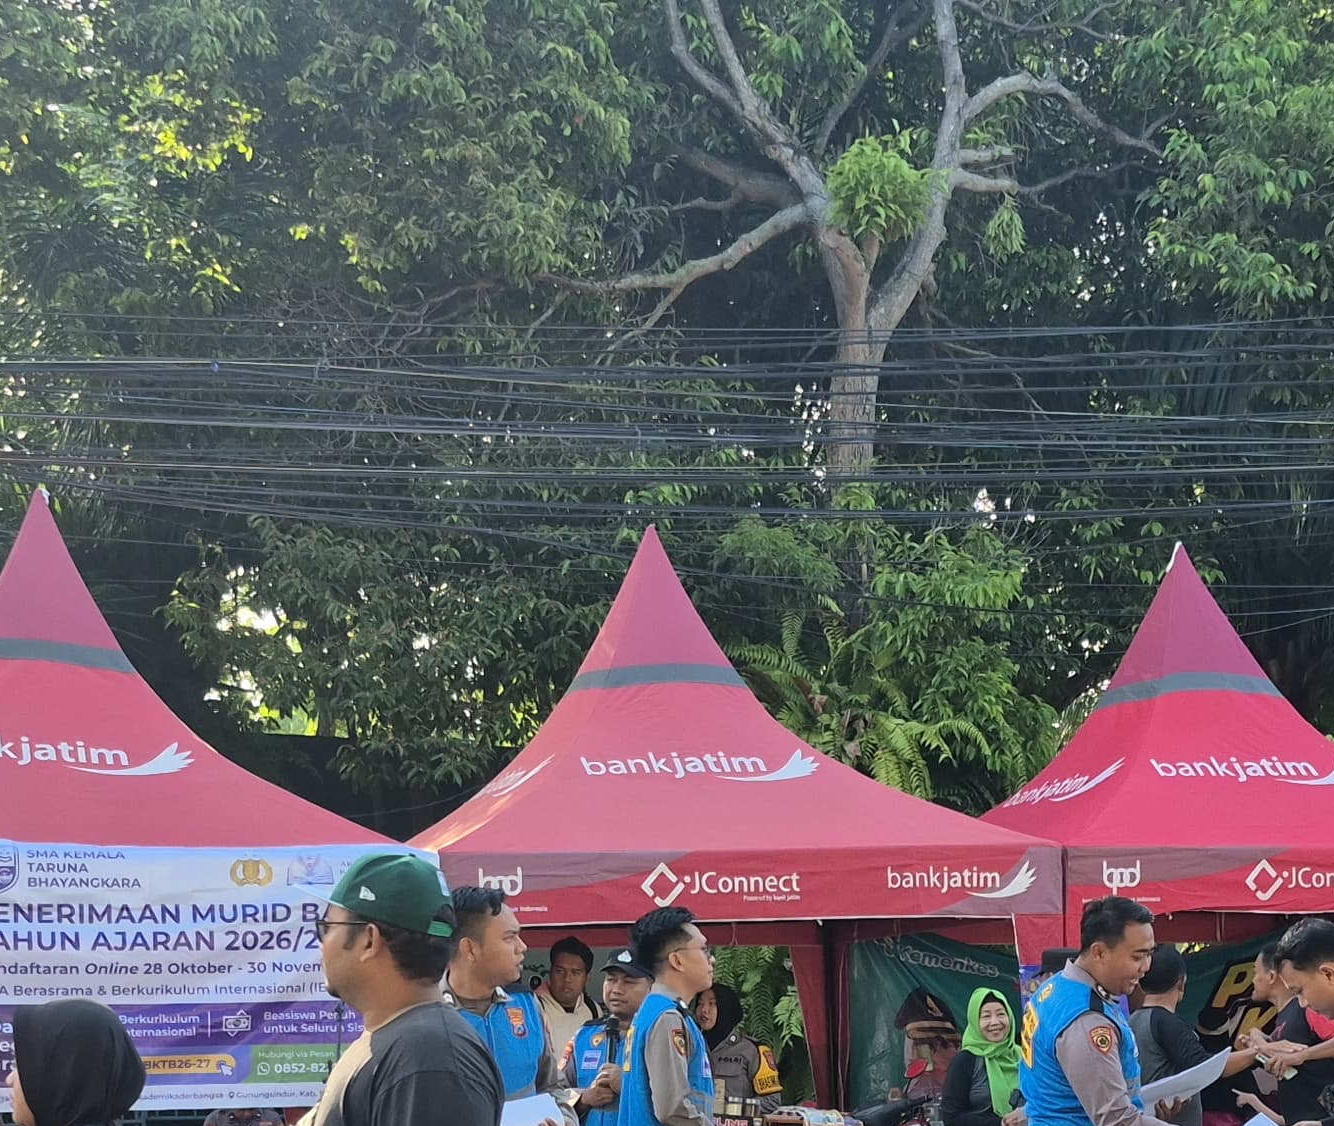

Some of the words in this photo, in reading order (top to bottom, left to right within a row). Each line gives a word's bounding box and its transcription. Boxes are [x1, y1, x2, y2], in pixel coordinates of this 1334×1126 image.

[580, 751, 767, 778] bankjatim
[1150, 756, 1318, 782] bankjatim
[63, 850, 125, 860] KEMALA
[27, 862, 88, 873] TARUNA
[28, 877, 141, 888] BHAYANGKARA
[690, 871, 800, 895] JConnect
[887, 866, 1000, 893] bankjatim
[192, 902, 292, 924] MURID
[92, 930, 216, 951] AJARAN
[85, 962, 139, 975] Online
[143, 963, 162, 975] 28
[167, 961, 233, 975] Oktober
[247, 962, 267, 974] 30
[14, 985, 93, 996] Berasrama
[98, 985, 106, 996] &
[112, 984, 211, 996] Berkurikulum
[214, 982, 306, 995] Internasional
[264, 1010, 316, 1021] Beasiswa
[264, 1024, 298, 1034] untuk
[718, 1056, 742, 1065] POLRI
